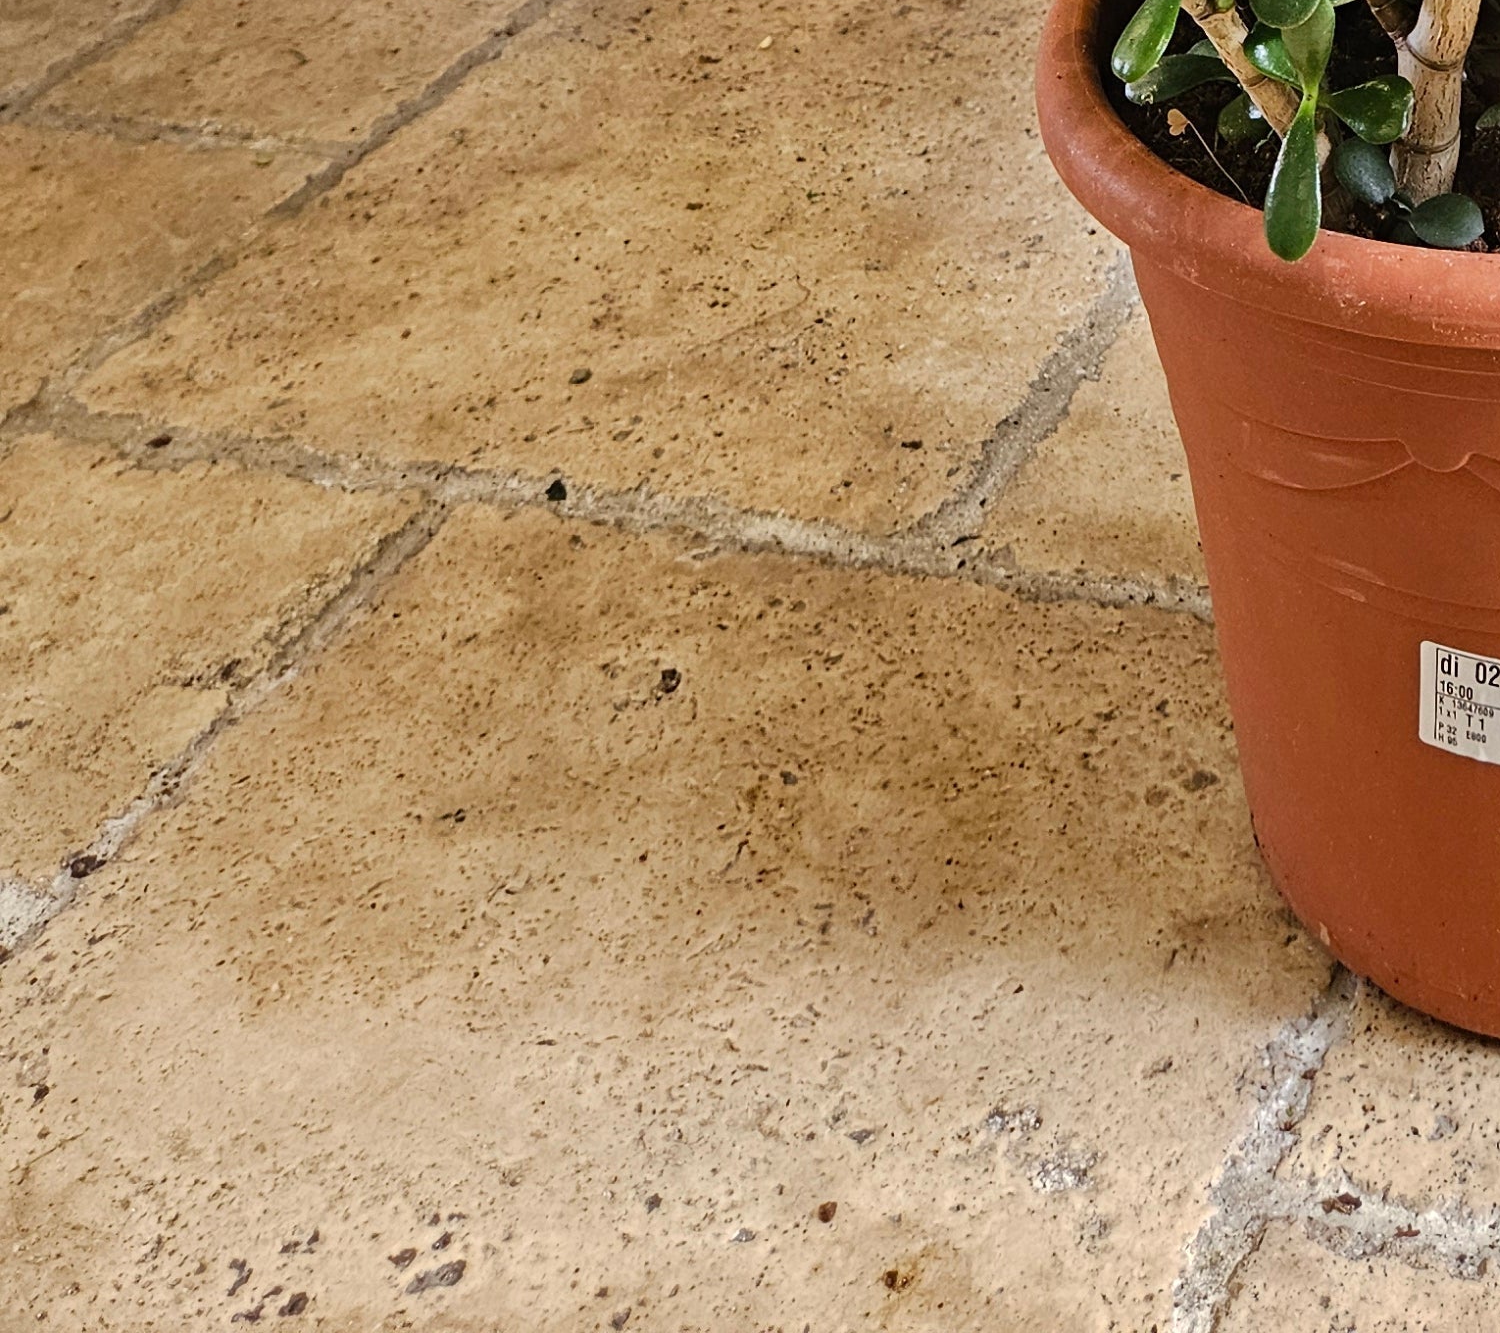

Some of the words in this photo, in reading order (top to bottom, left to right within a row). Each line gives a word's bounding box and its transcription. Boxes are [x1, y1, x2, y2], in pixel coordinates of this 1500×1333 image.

[1440, 654, 1459, 678] di
[1475, 662, 1500, 688] 02
[1440, 680, 1474, 701] 16:00
[1438, 721, 1444, 731] P
[1446, 725, 1457, 736] 32
[1465, 713, 1474, 727] T
[1478, 718, 1484, 731] 1
[1438, 733, 1444, 742] H
